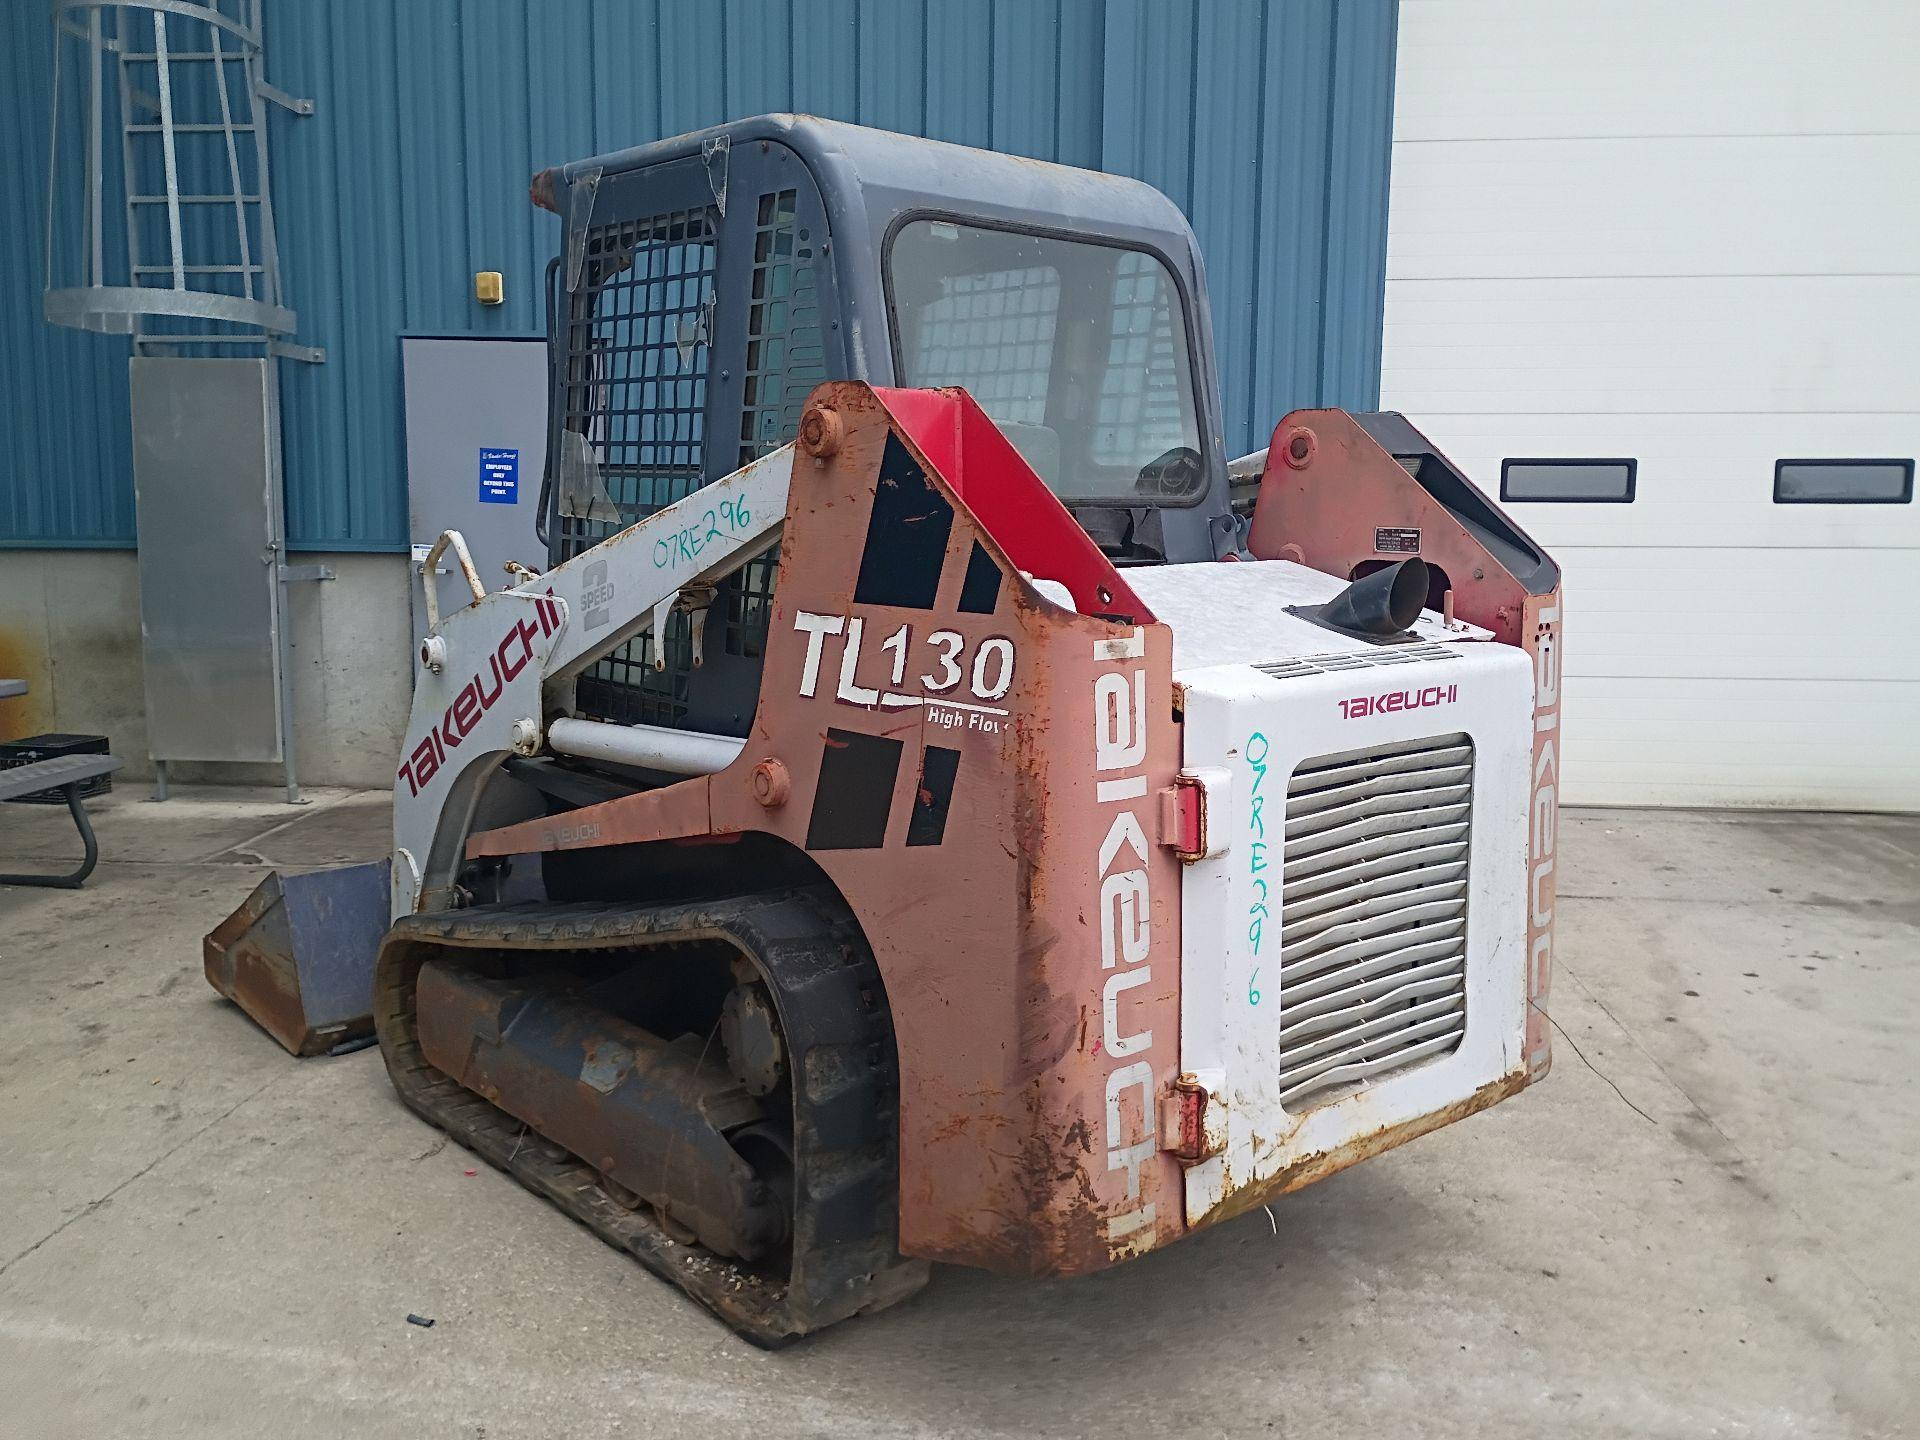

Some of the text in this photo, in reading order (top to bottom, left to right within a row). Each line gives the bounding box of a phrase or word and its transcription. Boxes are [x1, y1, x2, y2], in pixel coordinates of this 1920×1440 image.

[653, 494, 750, 570] 07RE296
[580, 582, 615, 612] SPEED
[927, 706, 964, 729] High
